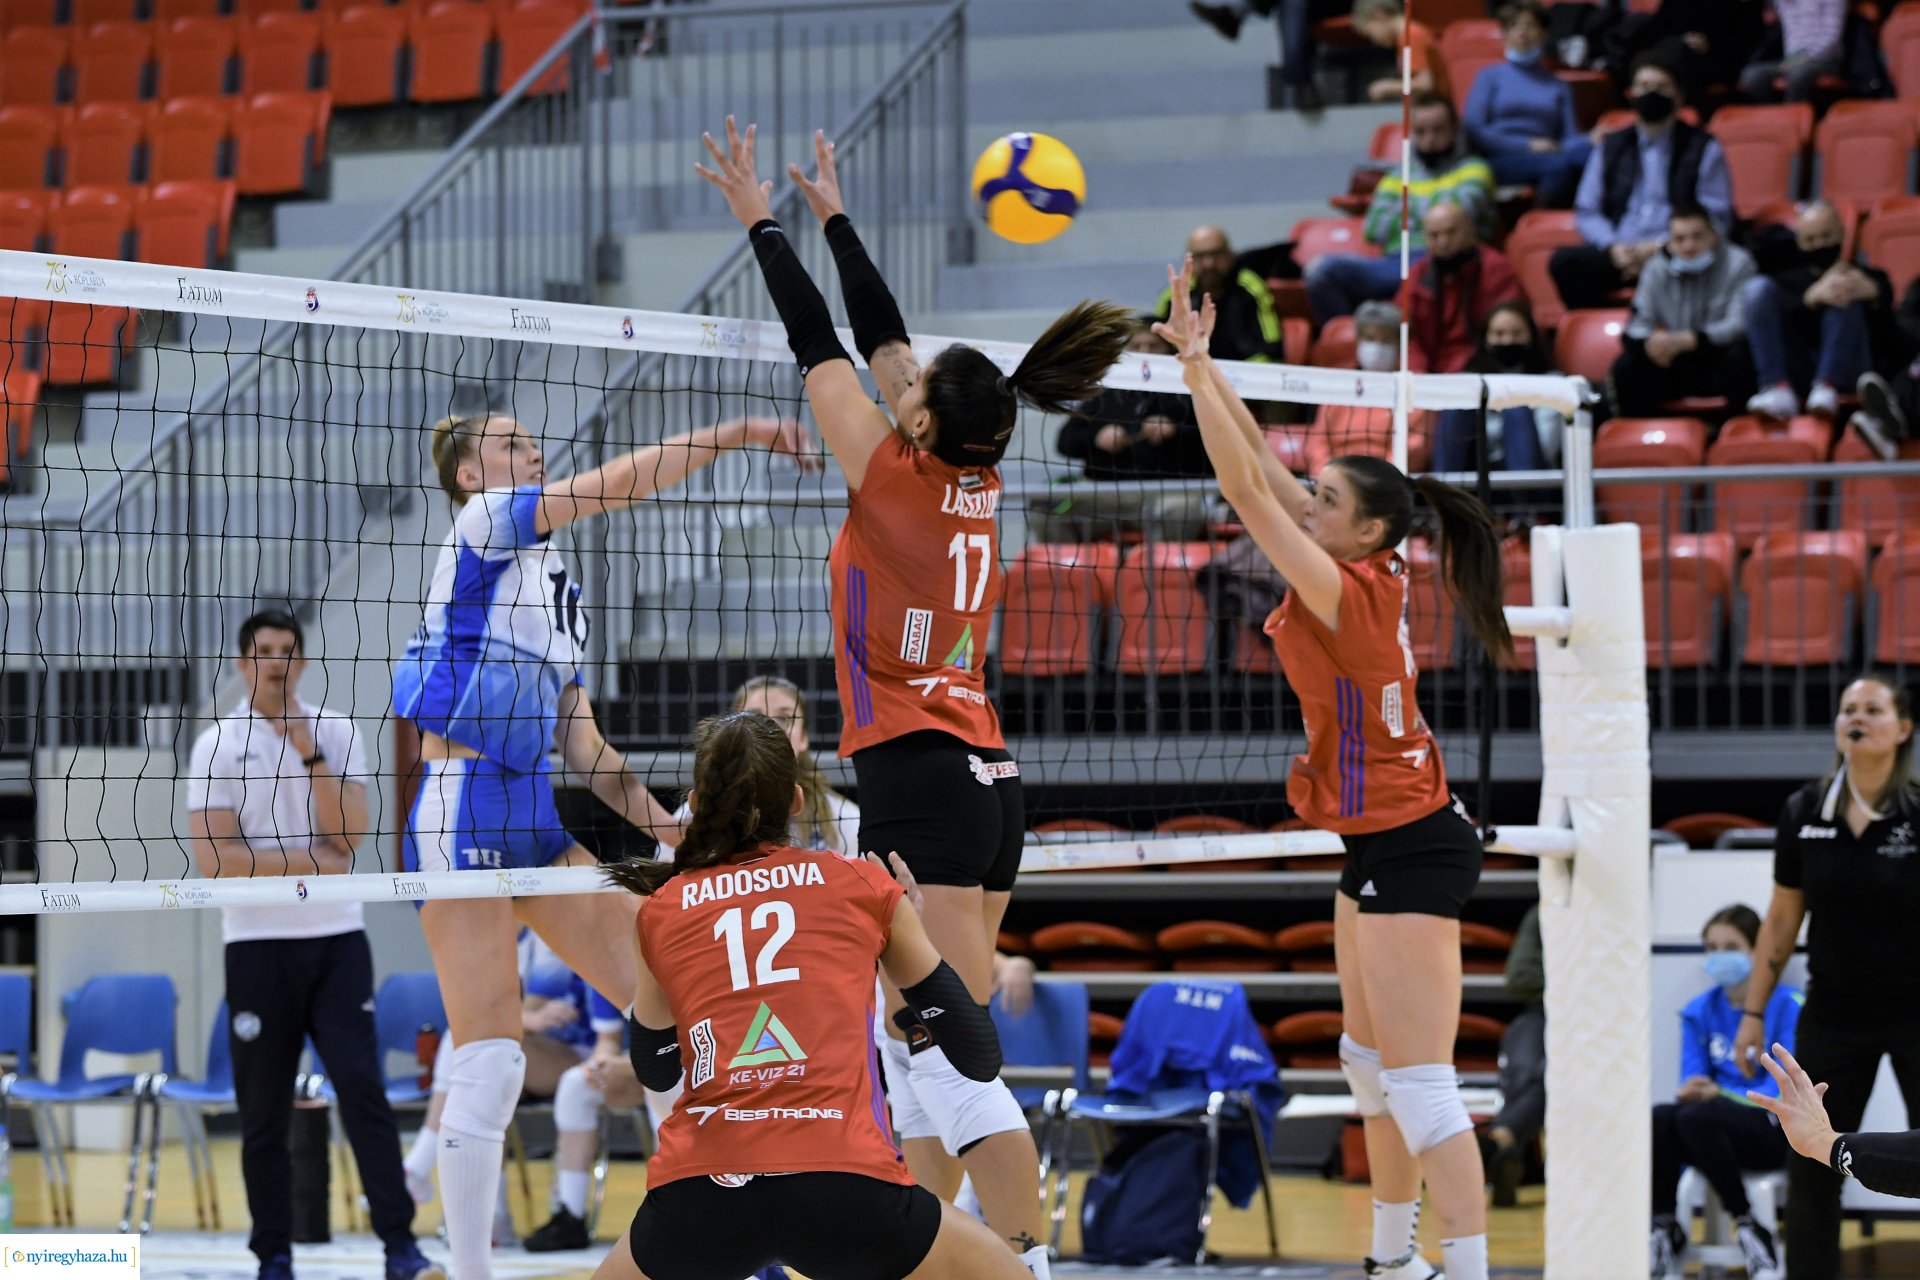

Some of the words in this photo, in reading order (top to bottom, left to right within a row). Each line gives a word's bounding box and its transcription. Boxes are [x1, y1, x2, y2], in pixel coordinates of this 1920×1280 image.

[948, 532, 991, 611] 17
[682, 862, 826, 910] RADOSOVA
[713, 900, 800, 991] 12
[696, 1025, 709, 1082] STRABAG
[729, 1066, 785, 1085] KE-VIZ
[786, 1064, 806, 1076] 21
[724, 1107, 844, 1121] BESTRONG
